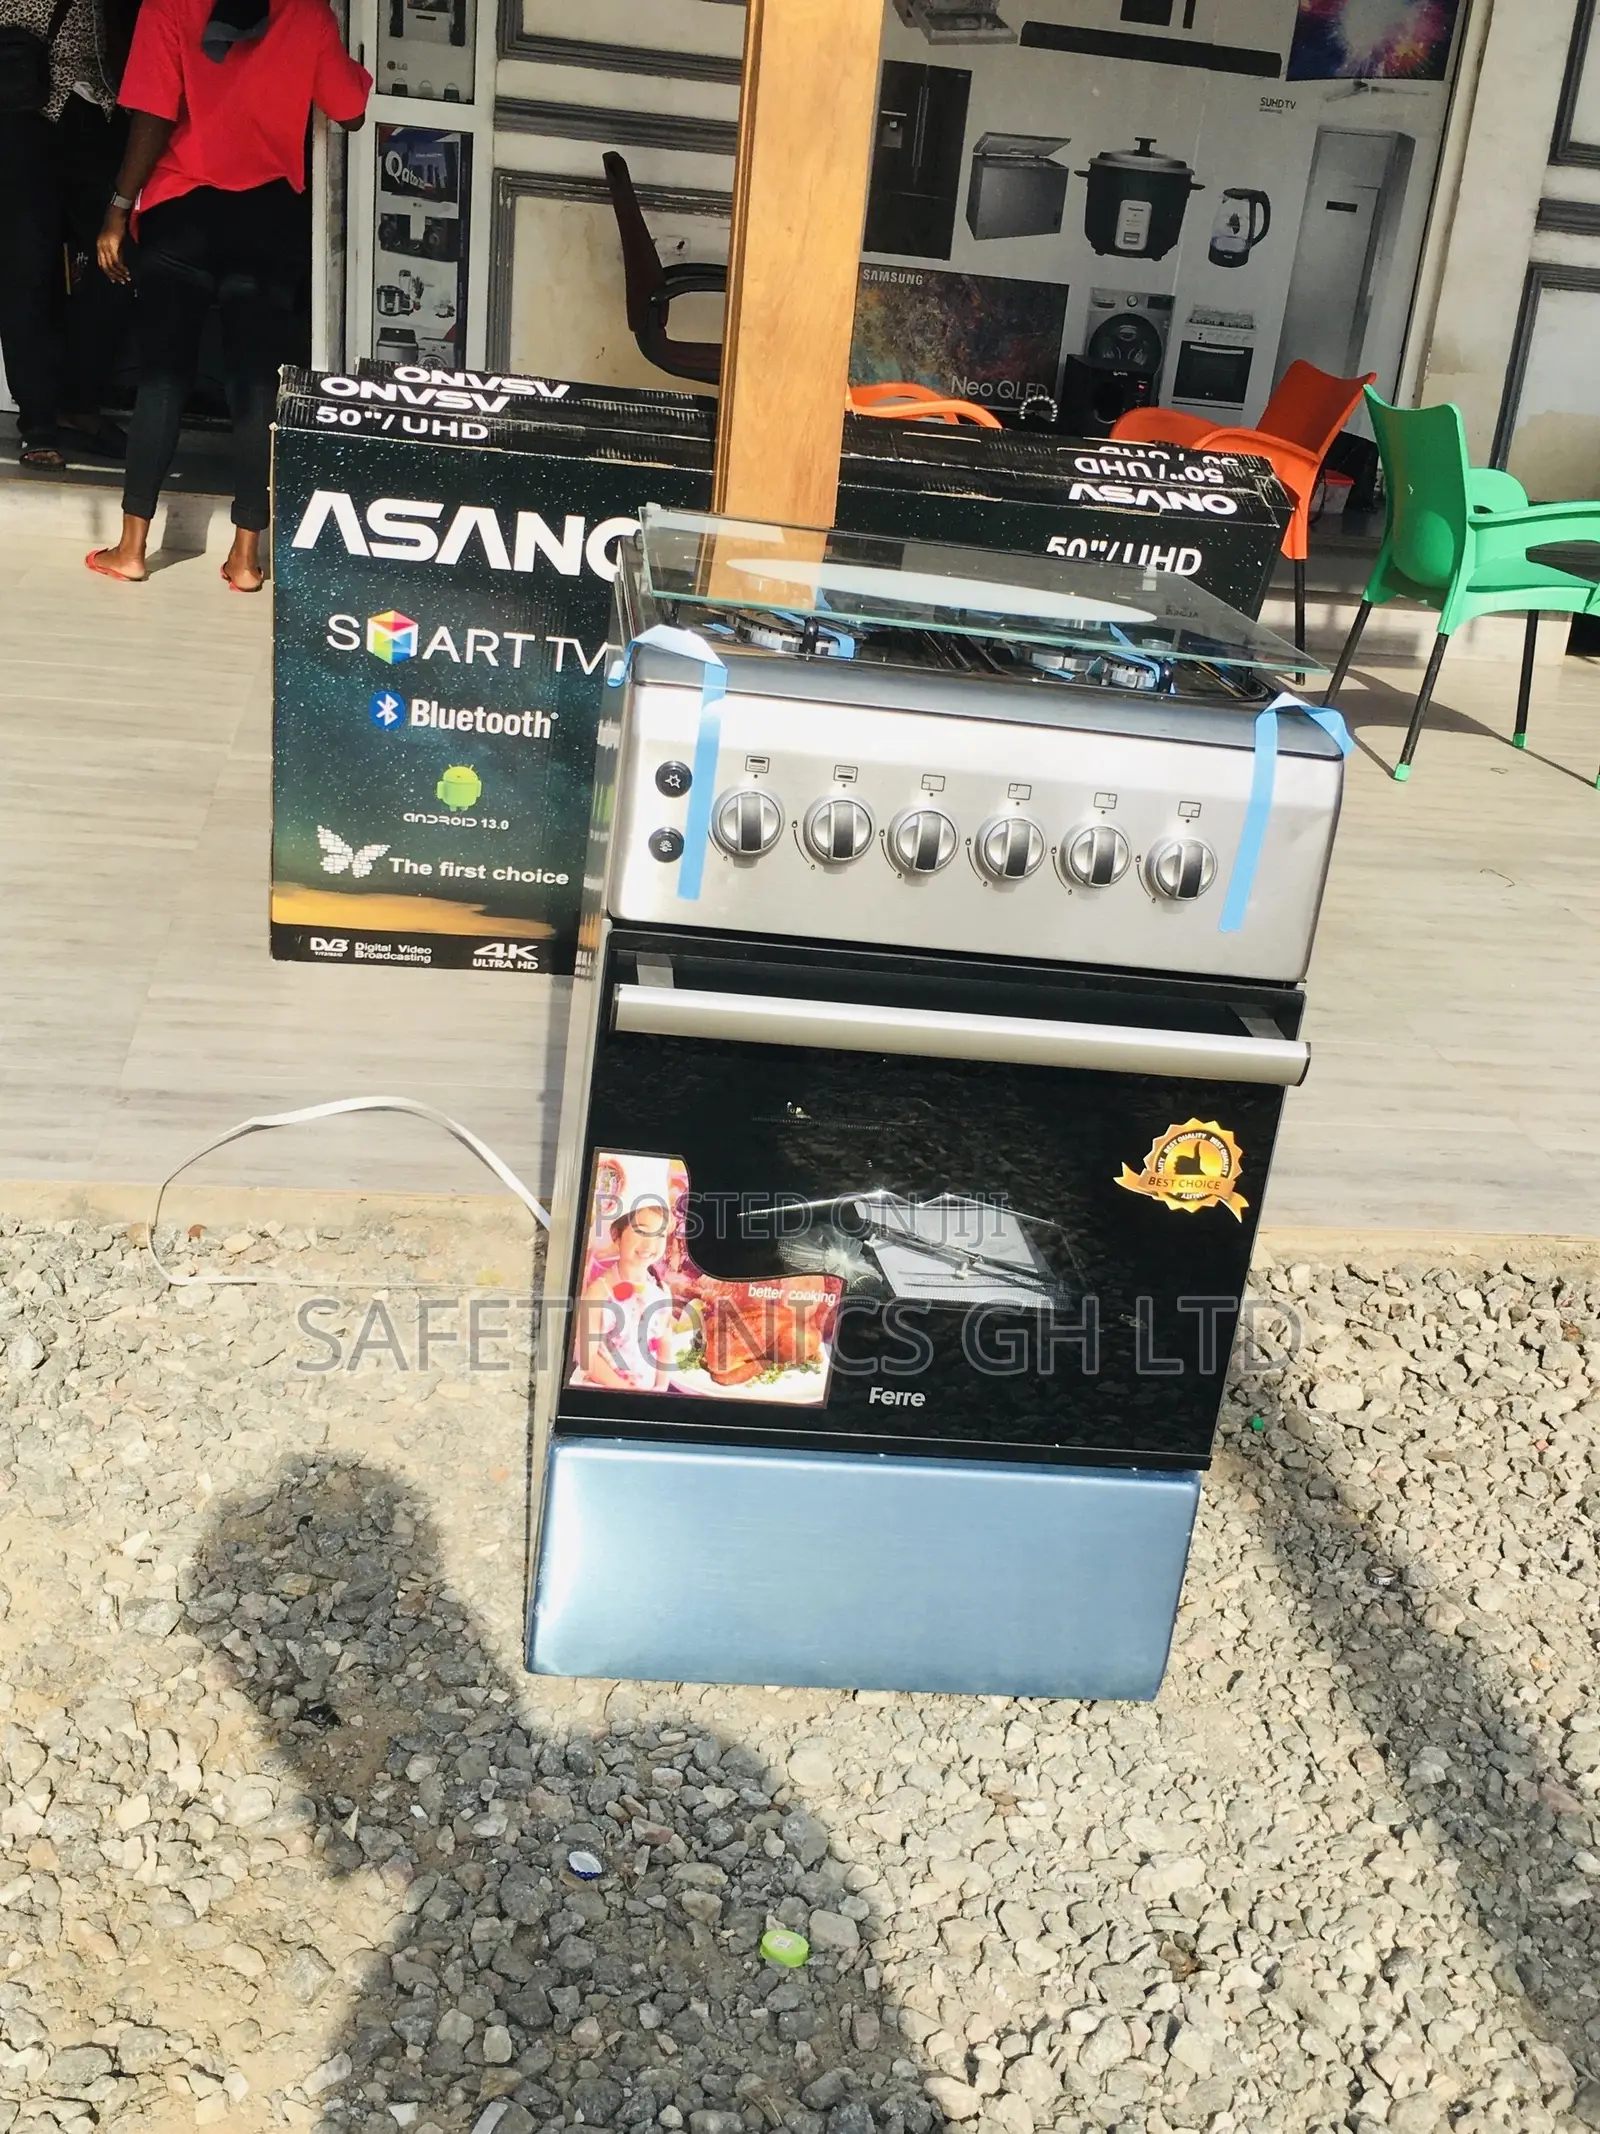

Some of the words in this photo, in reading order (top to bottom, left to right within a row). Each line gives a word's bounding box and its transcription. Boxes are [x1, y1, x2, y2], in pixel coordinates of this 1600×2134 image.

[863, 269, 923, 286] SAMSUNG
[951, 376, 993, 397] Neo
[998, 380, 1048, 400] QLED
[1068, 483, 1238, 515] ASANO
[546, 636, 609, 676] TV
[481, 818, 510, 831] 13.0
[389, 857, 433, 876] The
[439, 861, 487, 880] first
[493, 866, 570, 885] choice
[310, 937, 349, 952] DVB
[354, 942, 392, 953] Digital
[398, 944, 433, 955] Video
[473, 943, 539, 961] 4K
[354, 950, 432, 964] Broadcasting
[472, 958, 514, 969] ULTRA
[517, 960, 539, 970] HD
[1163, 1139, 1178, 1154] BEST
[1177, 1132, 1207, 1142] QUALITY
[1209, 1136, 1224, 1149] BEST
[1221, 1148, 1230, 1176] QUALITY
[1148, 1176, 1176, 1188] BEST
[1178, 1179, 1222, 1190] CHOICE
[748, 1284, 784, 1299] better
[789, 1290, 836, 1307] cooking
[869, 1386, 926, 1407] Ferre
